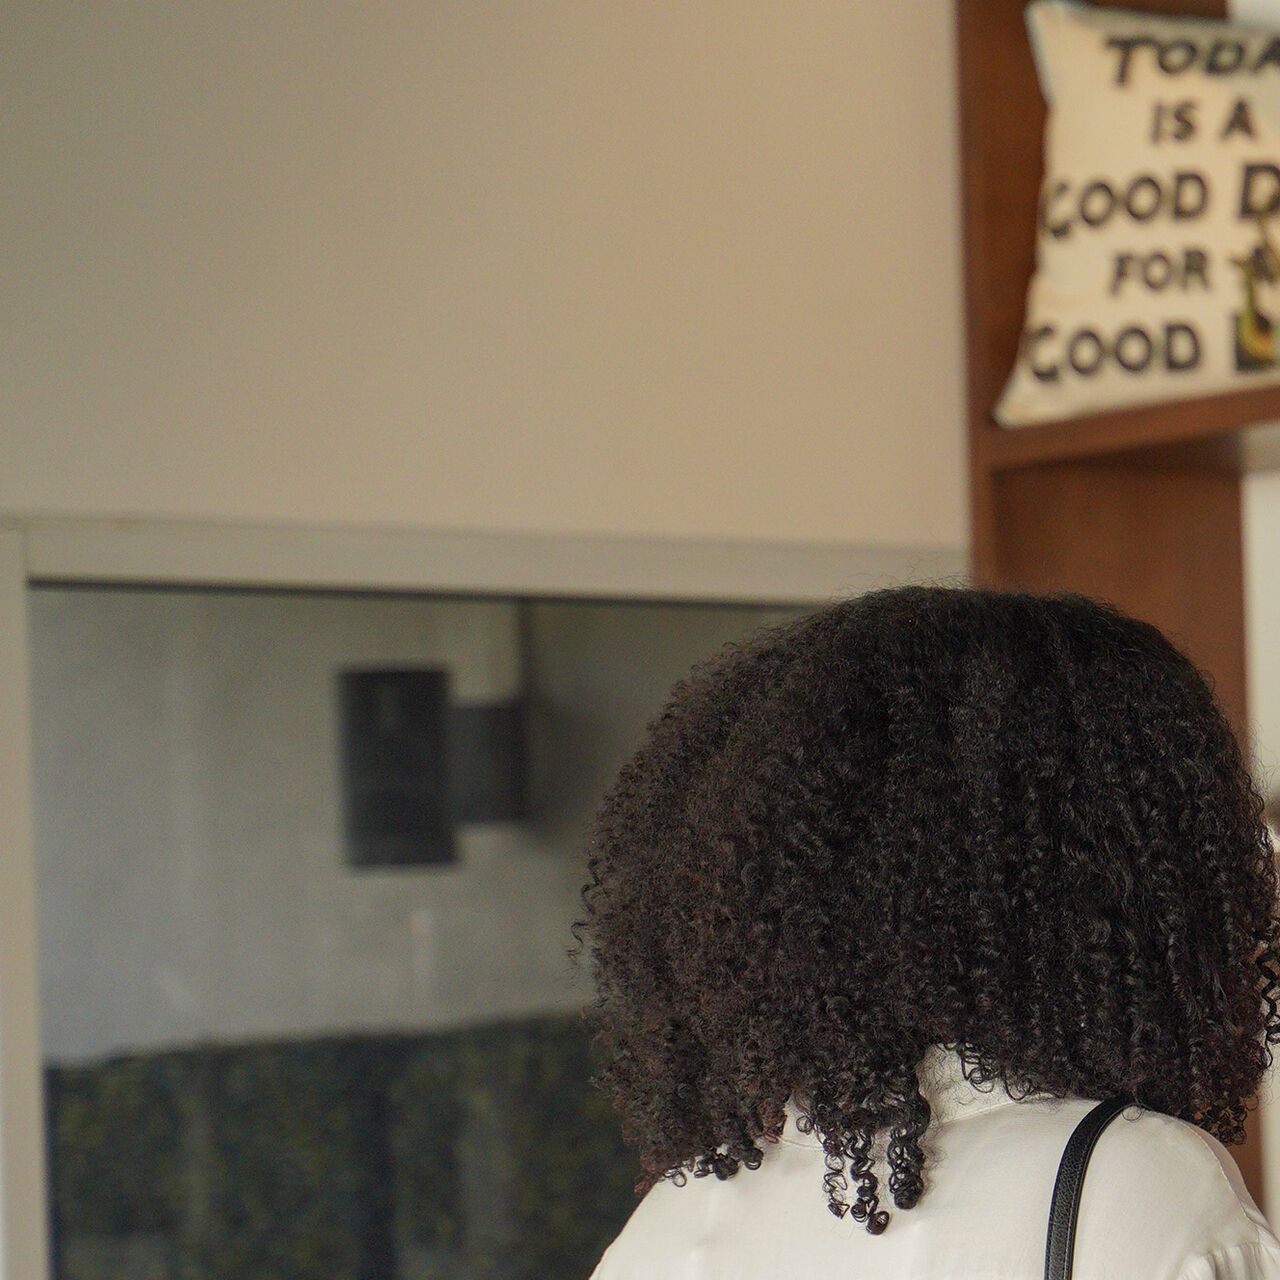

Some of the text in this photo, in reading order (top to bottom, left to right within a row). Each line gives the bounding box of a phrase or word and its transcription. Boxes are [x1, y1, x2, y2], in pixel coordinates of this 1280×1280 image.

[1152, 96, 1257, 143] IS A
[1111, 249, 1208, 294] FOR
